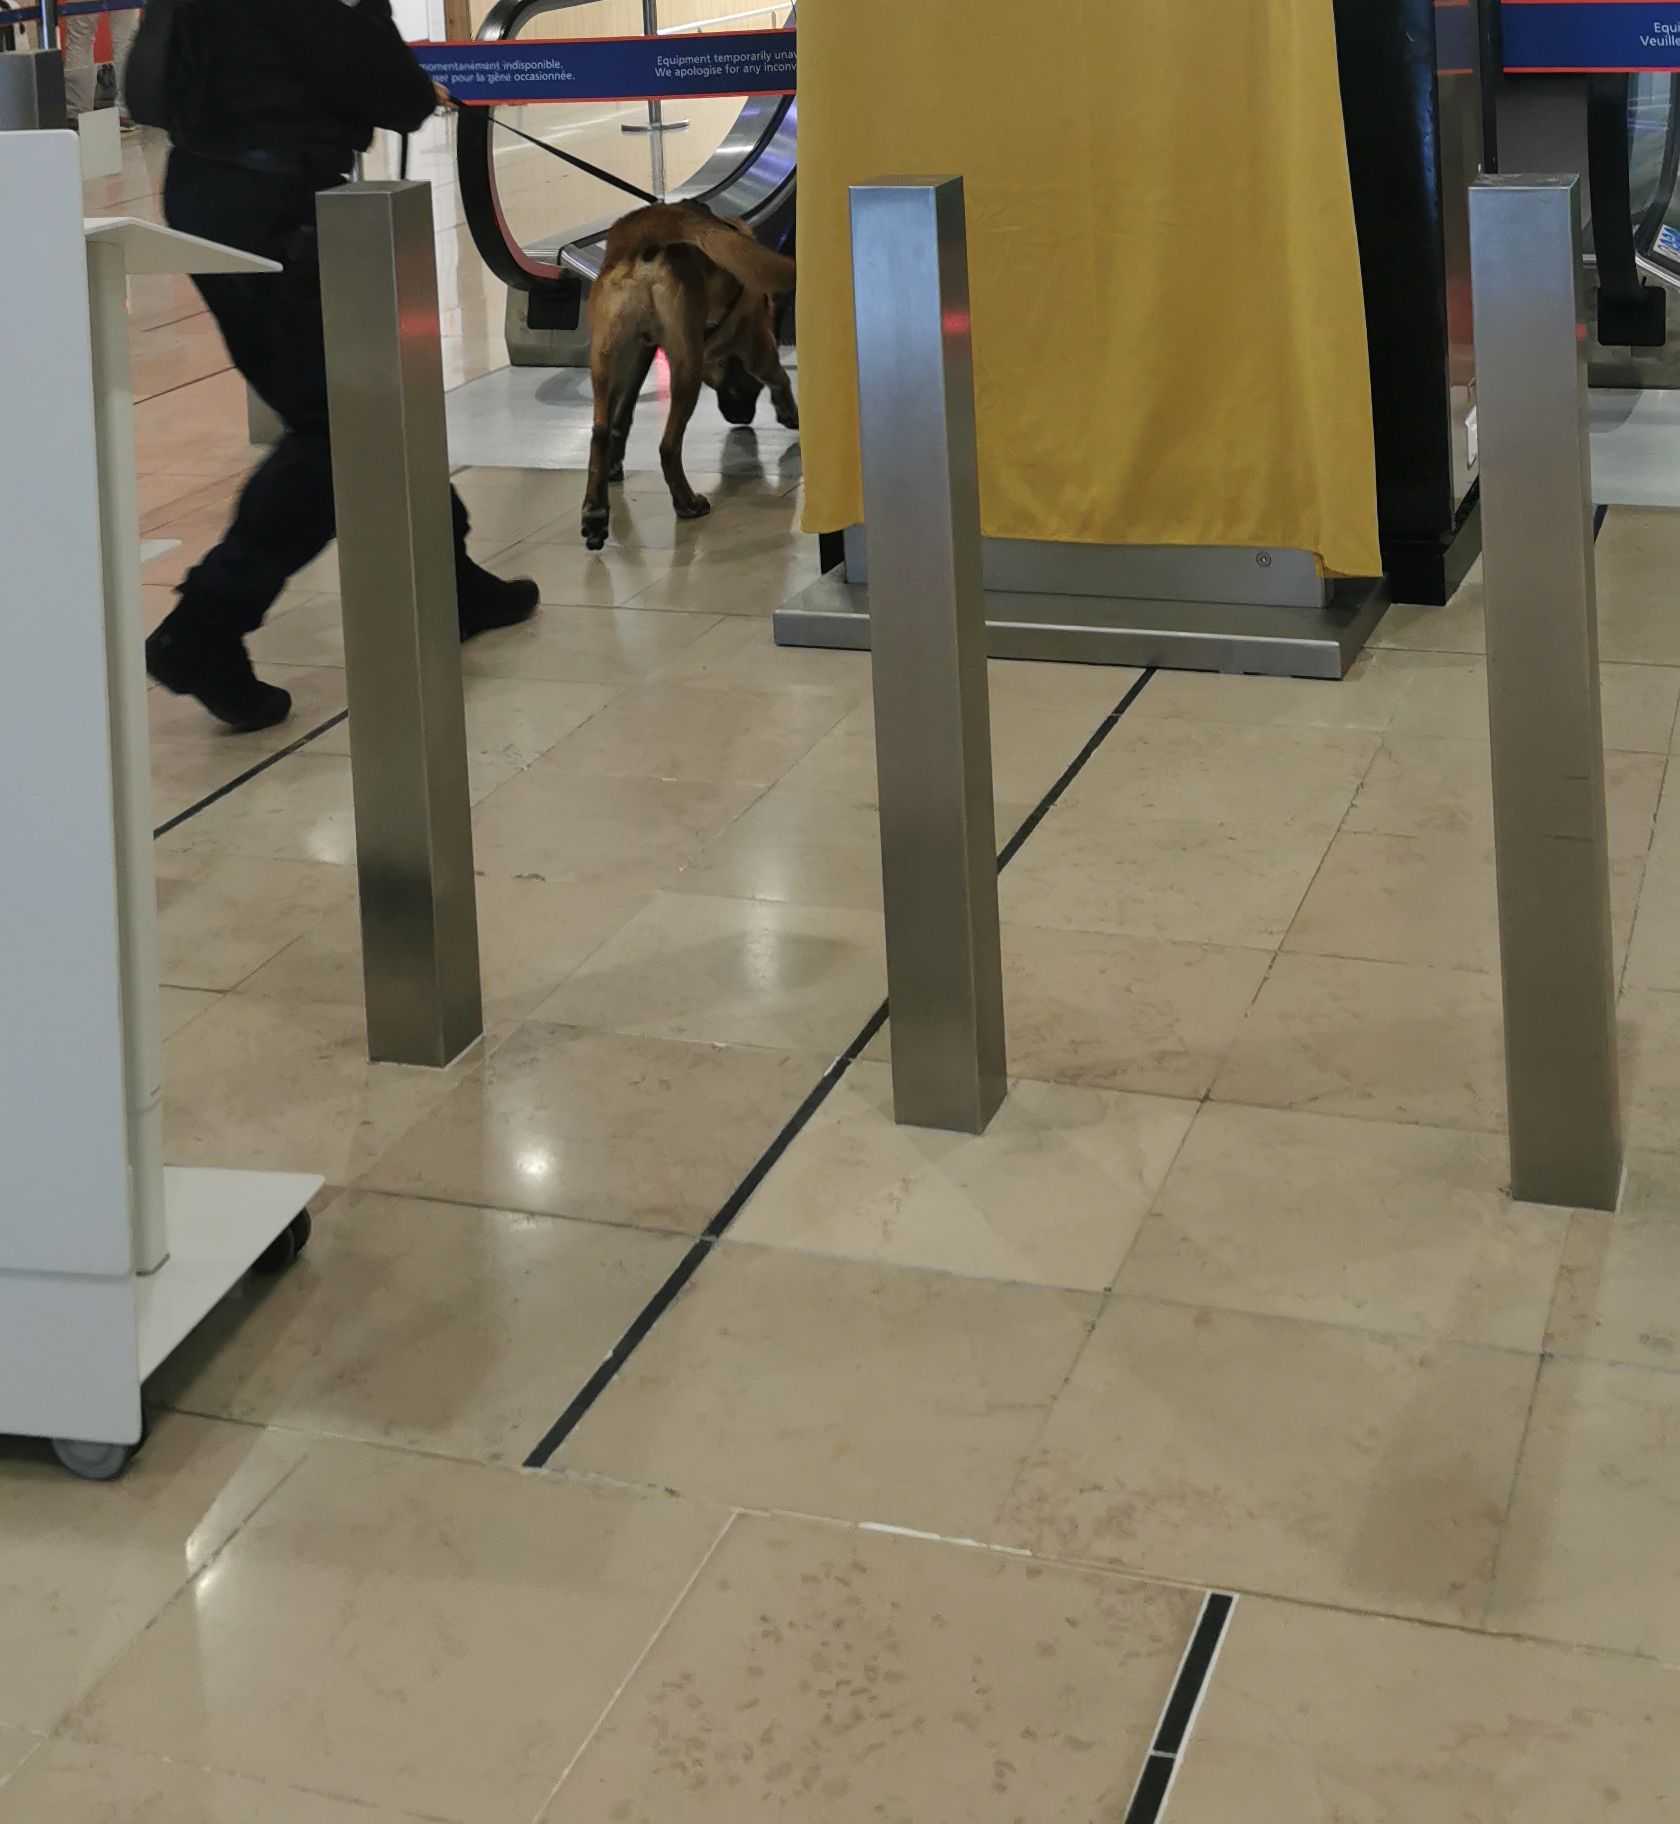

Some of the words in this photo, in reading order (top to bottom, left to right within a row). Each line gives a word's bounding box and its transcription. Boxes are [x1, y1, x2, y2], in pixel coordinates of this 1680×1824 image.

[657, 54, 711, 67] Equipment
[714, 50, 772, 65] temporarily
[451, 74, 474, 84] pour
[514, 71, 576, 82] occasionnée.
[654, 67, 672, 77] We
[674, 65, 722, 78] apologise
[725, 63, 740, 74] for
[743, 64, 761, 74] any
